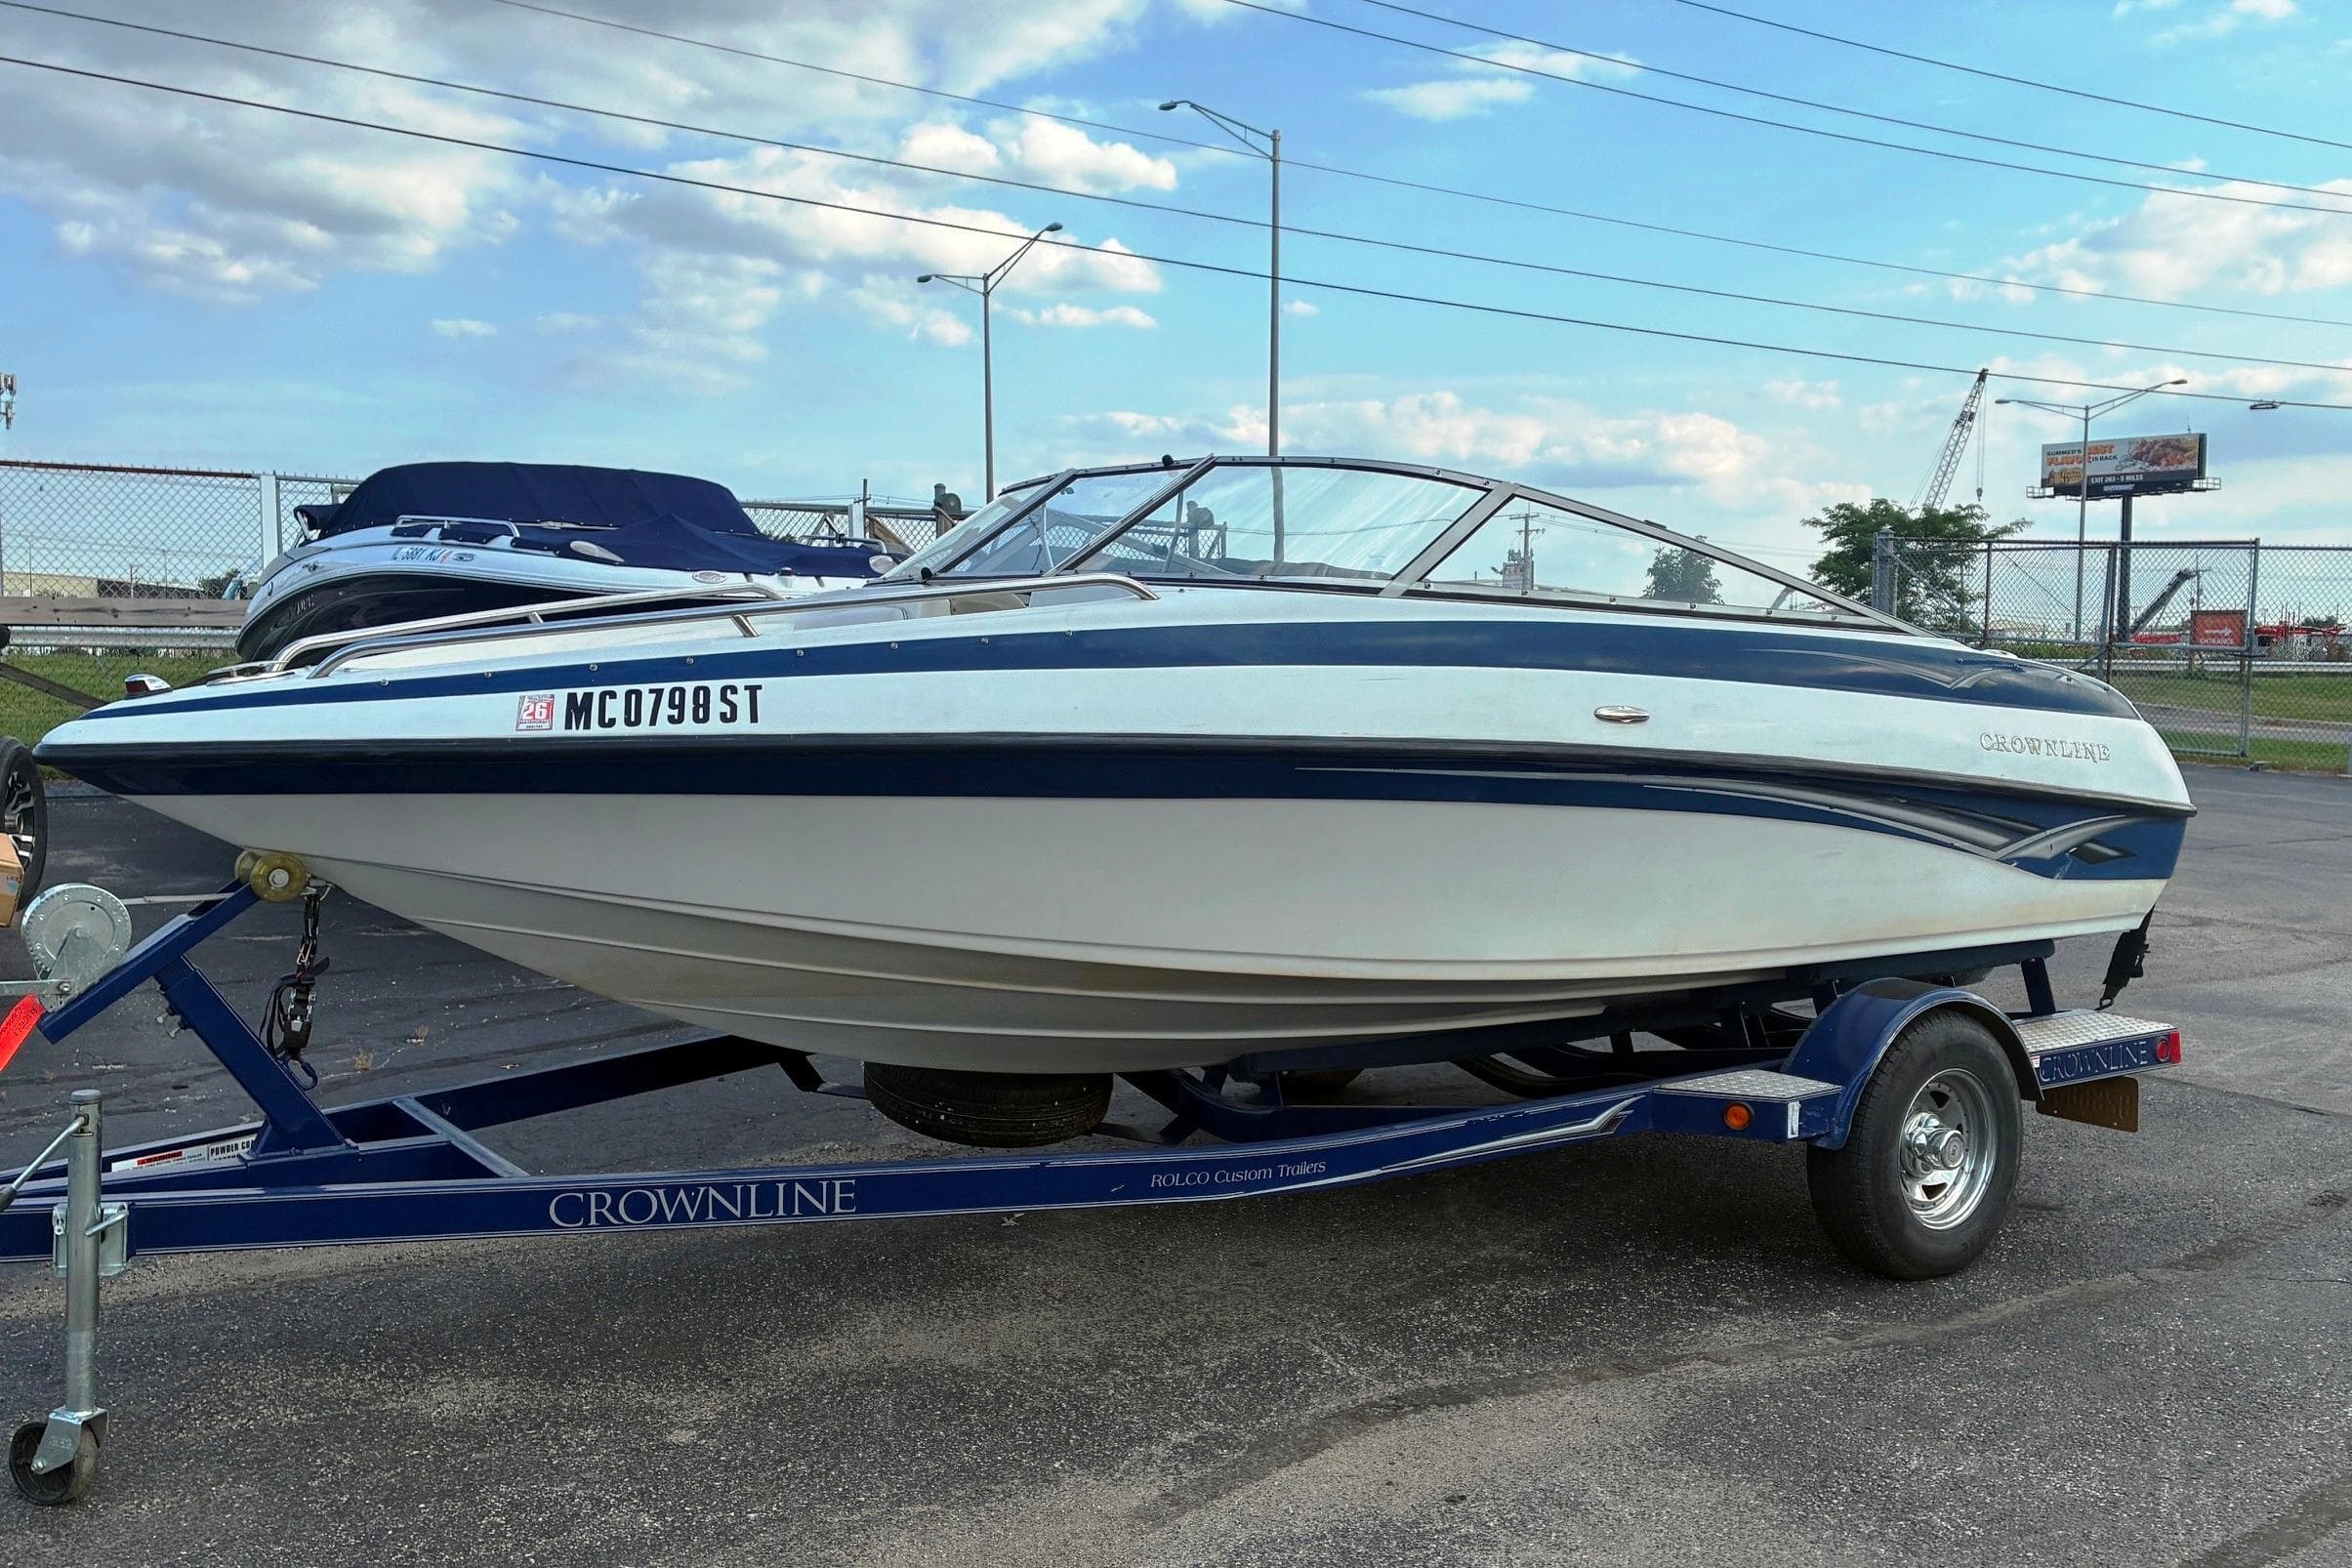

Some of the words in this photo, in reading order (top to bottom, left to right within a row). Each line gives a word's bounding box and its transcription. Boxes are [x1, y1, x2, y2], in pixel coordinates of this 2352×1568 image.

[521, 702, 548, 720] 26
[1980, 732, 2110, 763] CROWNLINE
[2039, 1041, 2148, 1083] CROWNLINE
[210, 1143, 239, 1157] POWDER
[1150, 1172, 1210, 1188] ROLCO
[1215, 1167, 1272, 1184] Custom
[1277, 1161, 1327, 1177] Trailers
[549, 1179, 857, 1229] CROWNLINE
